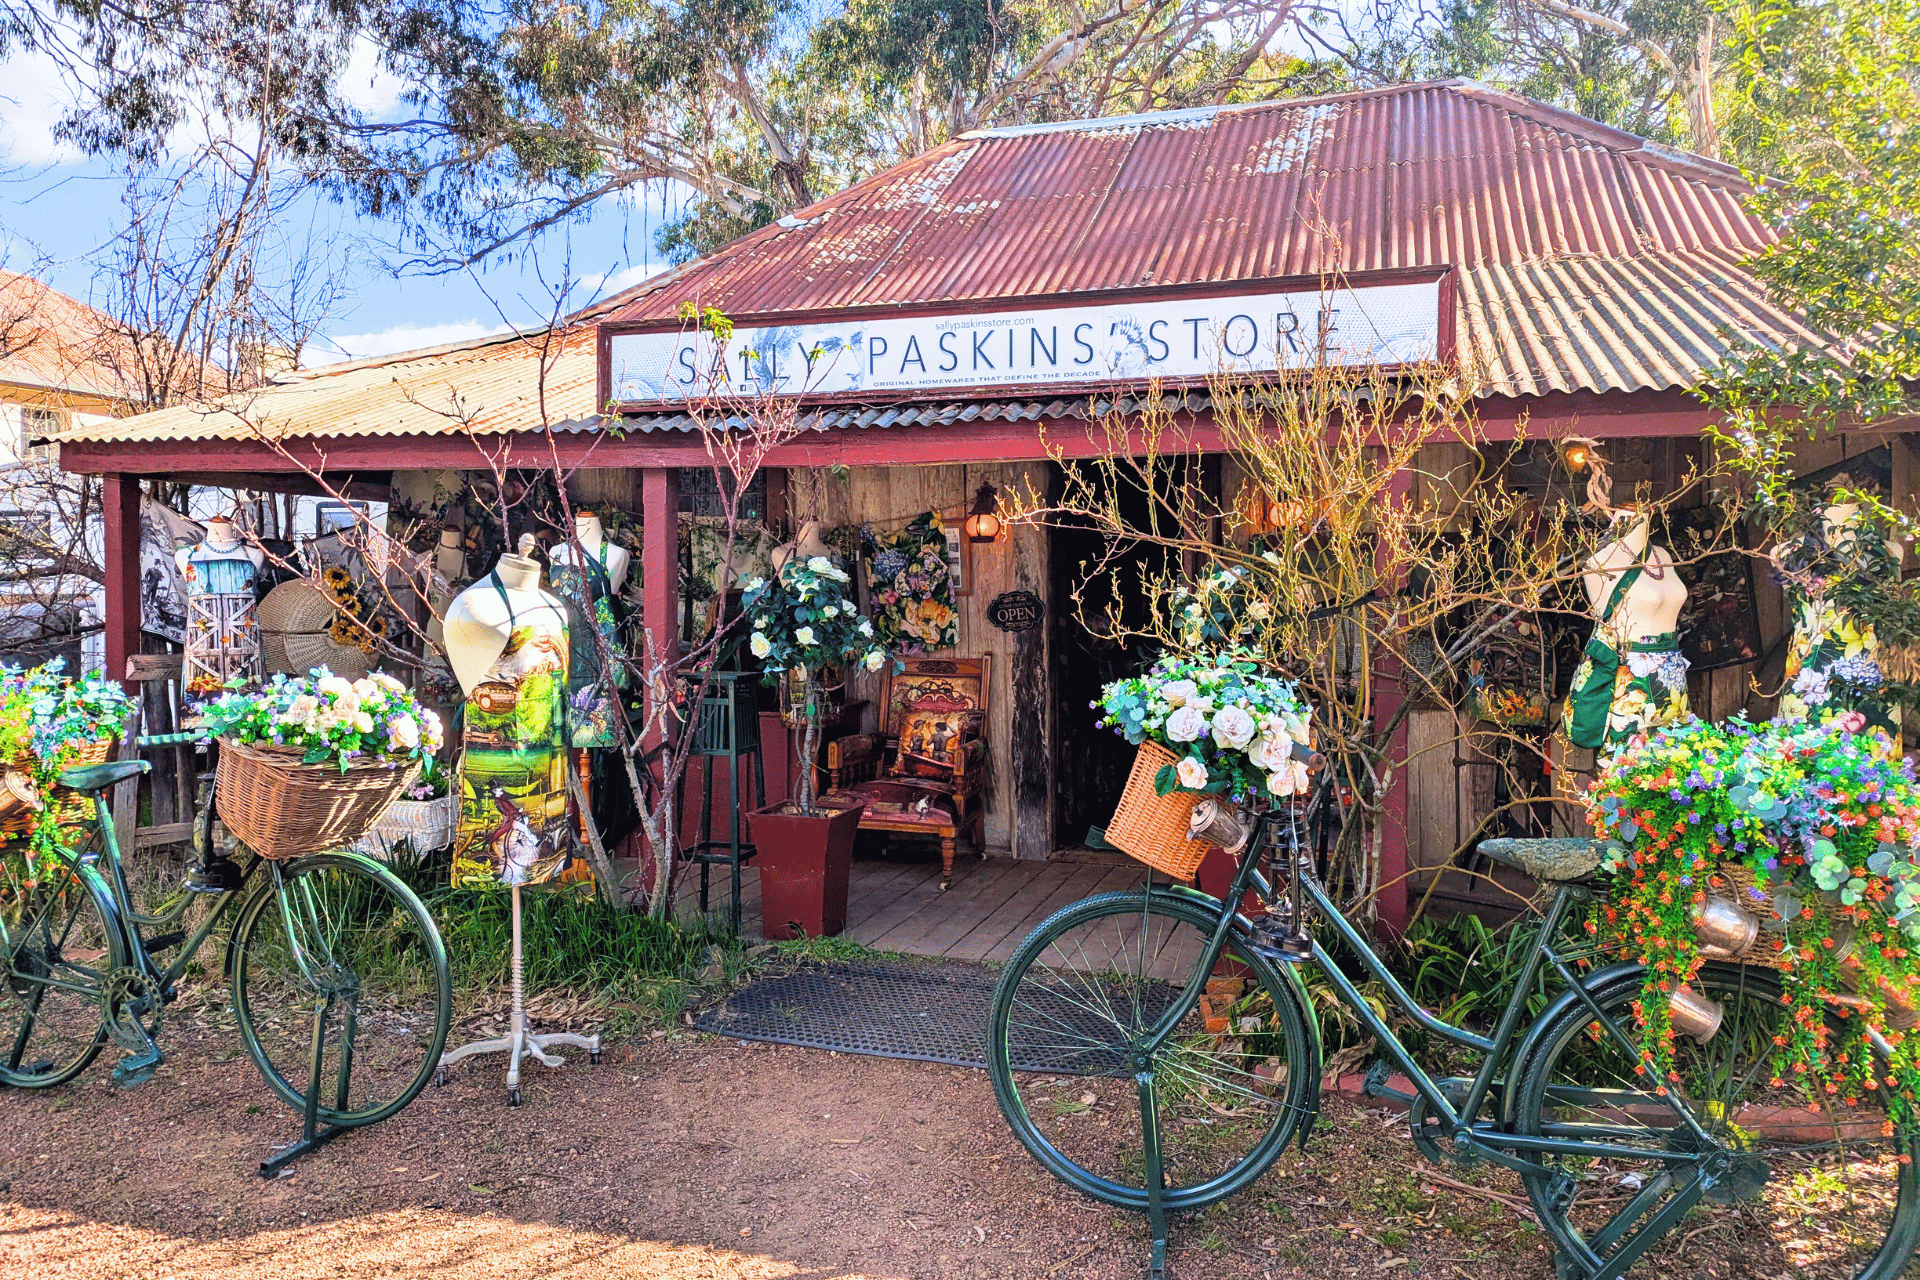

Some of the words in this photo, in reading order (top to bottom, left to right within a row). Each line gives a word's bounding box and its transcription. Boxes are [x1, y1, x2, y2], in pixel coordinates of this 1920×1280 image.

[935, 317, 1035, 332] sallypaskinsstore.com
[679, 340, 821, 385] SALLY
[1149, 309, 1341, 362] STORE
[873, 380, 916, 388] ORIGINAL
[919, 377, 976, 385] HOMEWARES
[1004, 373, 1040, 381] DEFINE
[1063, 370, 1101, 378] DECADE
[997, 606, 1036, 622] OPEN
